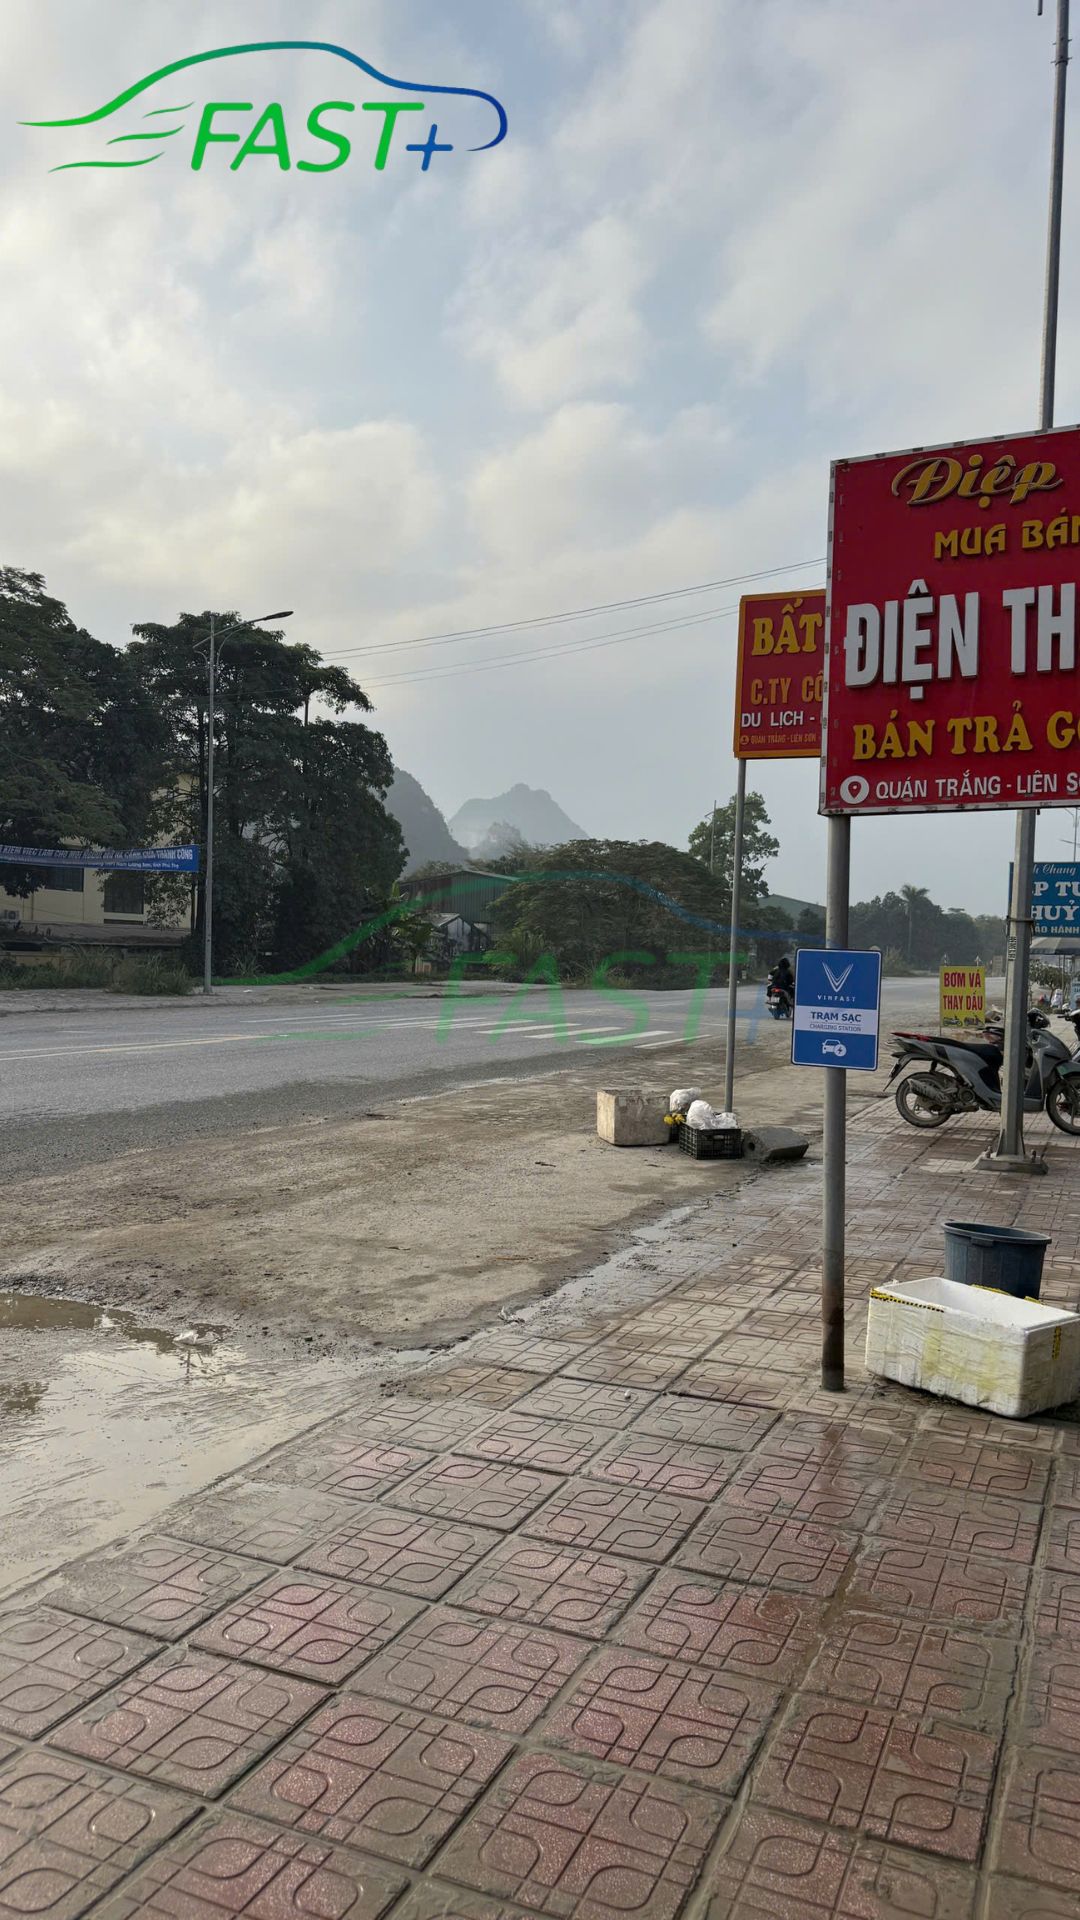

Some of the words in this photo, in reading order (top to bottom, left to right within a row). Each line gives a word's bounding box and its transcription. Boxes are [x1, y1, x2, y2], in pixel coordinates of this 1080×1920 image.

[891, 454, 1063, 508] Điệp
[934, 523, 1006, 559] MUA
[751, 598, 823, 656] BẤT
[844, 578, 979, 700] ĐIỆN
[751, 677, 792, 705] C.TY
[741, 712, 762, 727] DU
[770, 711, 804, 728] LỊCH
[852, 709, 936, 760] BÁN
[947, 700, 1033, 755] TRẢ
[1047, 711, 1080, 749] G
[876, 776, 928, 799] QUÁN
[935, 769, 1001, 798] TRẮNG
[1017, 770, 1057, 794] LIÊN
[1066, 771, 1080, 792] S
[943, 971, 965, 988] BƠM
[817, 994, 856, 1002] VINFAST
[943, 995, 963, 1010] THAY
[811, 1011, 839, 1022] TRẠM
[841, 1013, 862, 1023] SẠC
